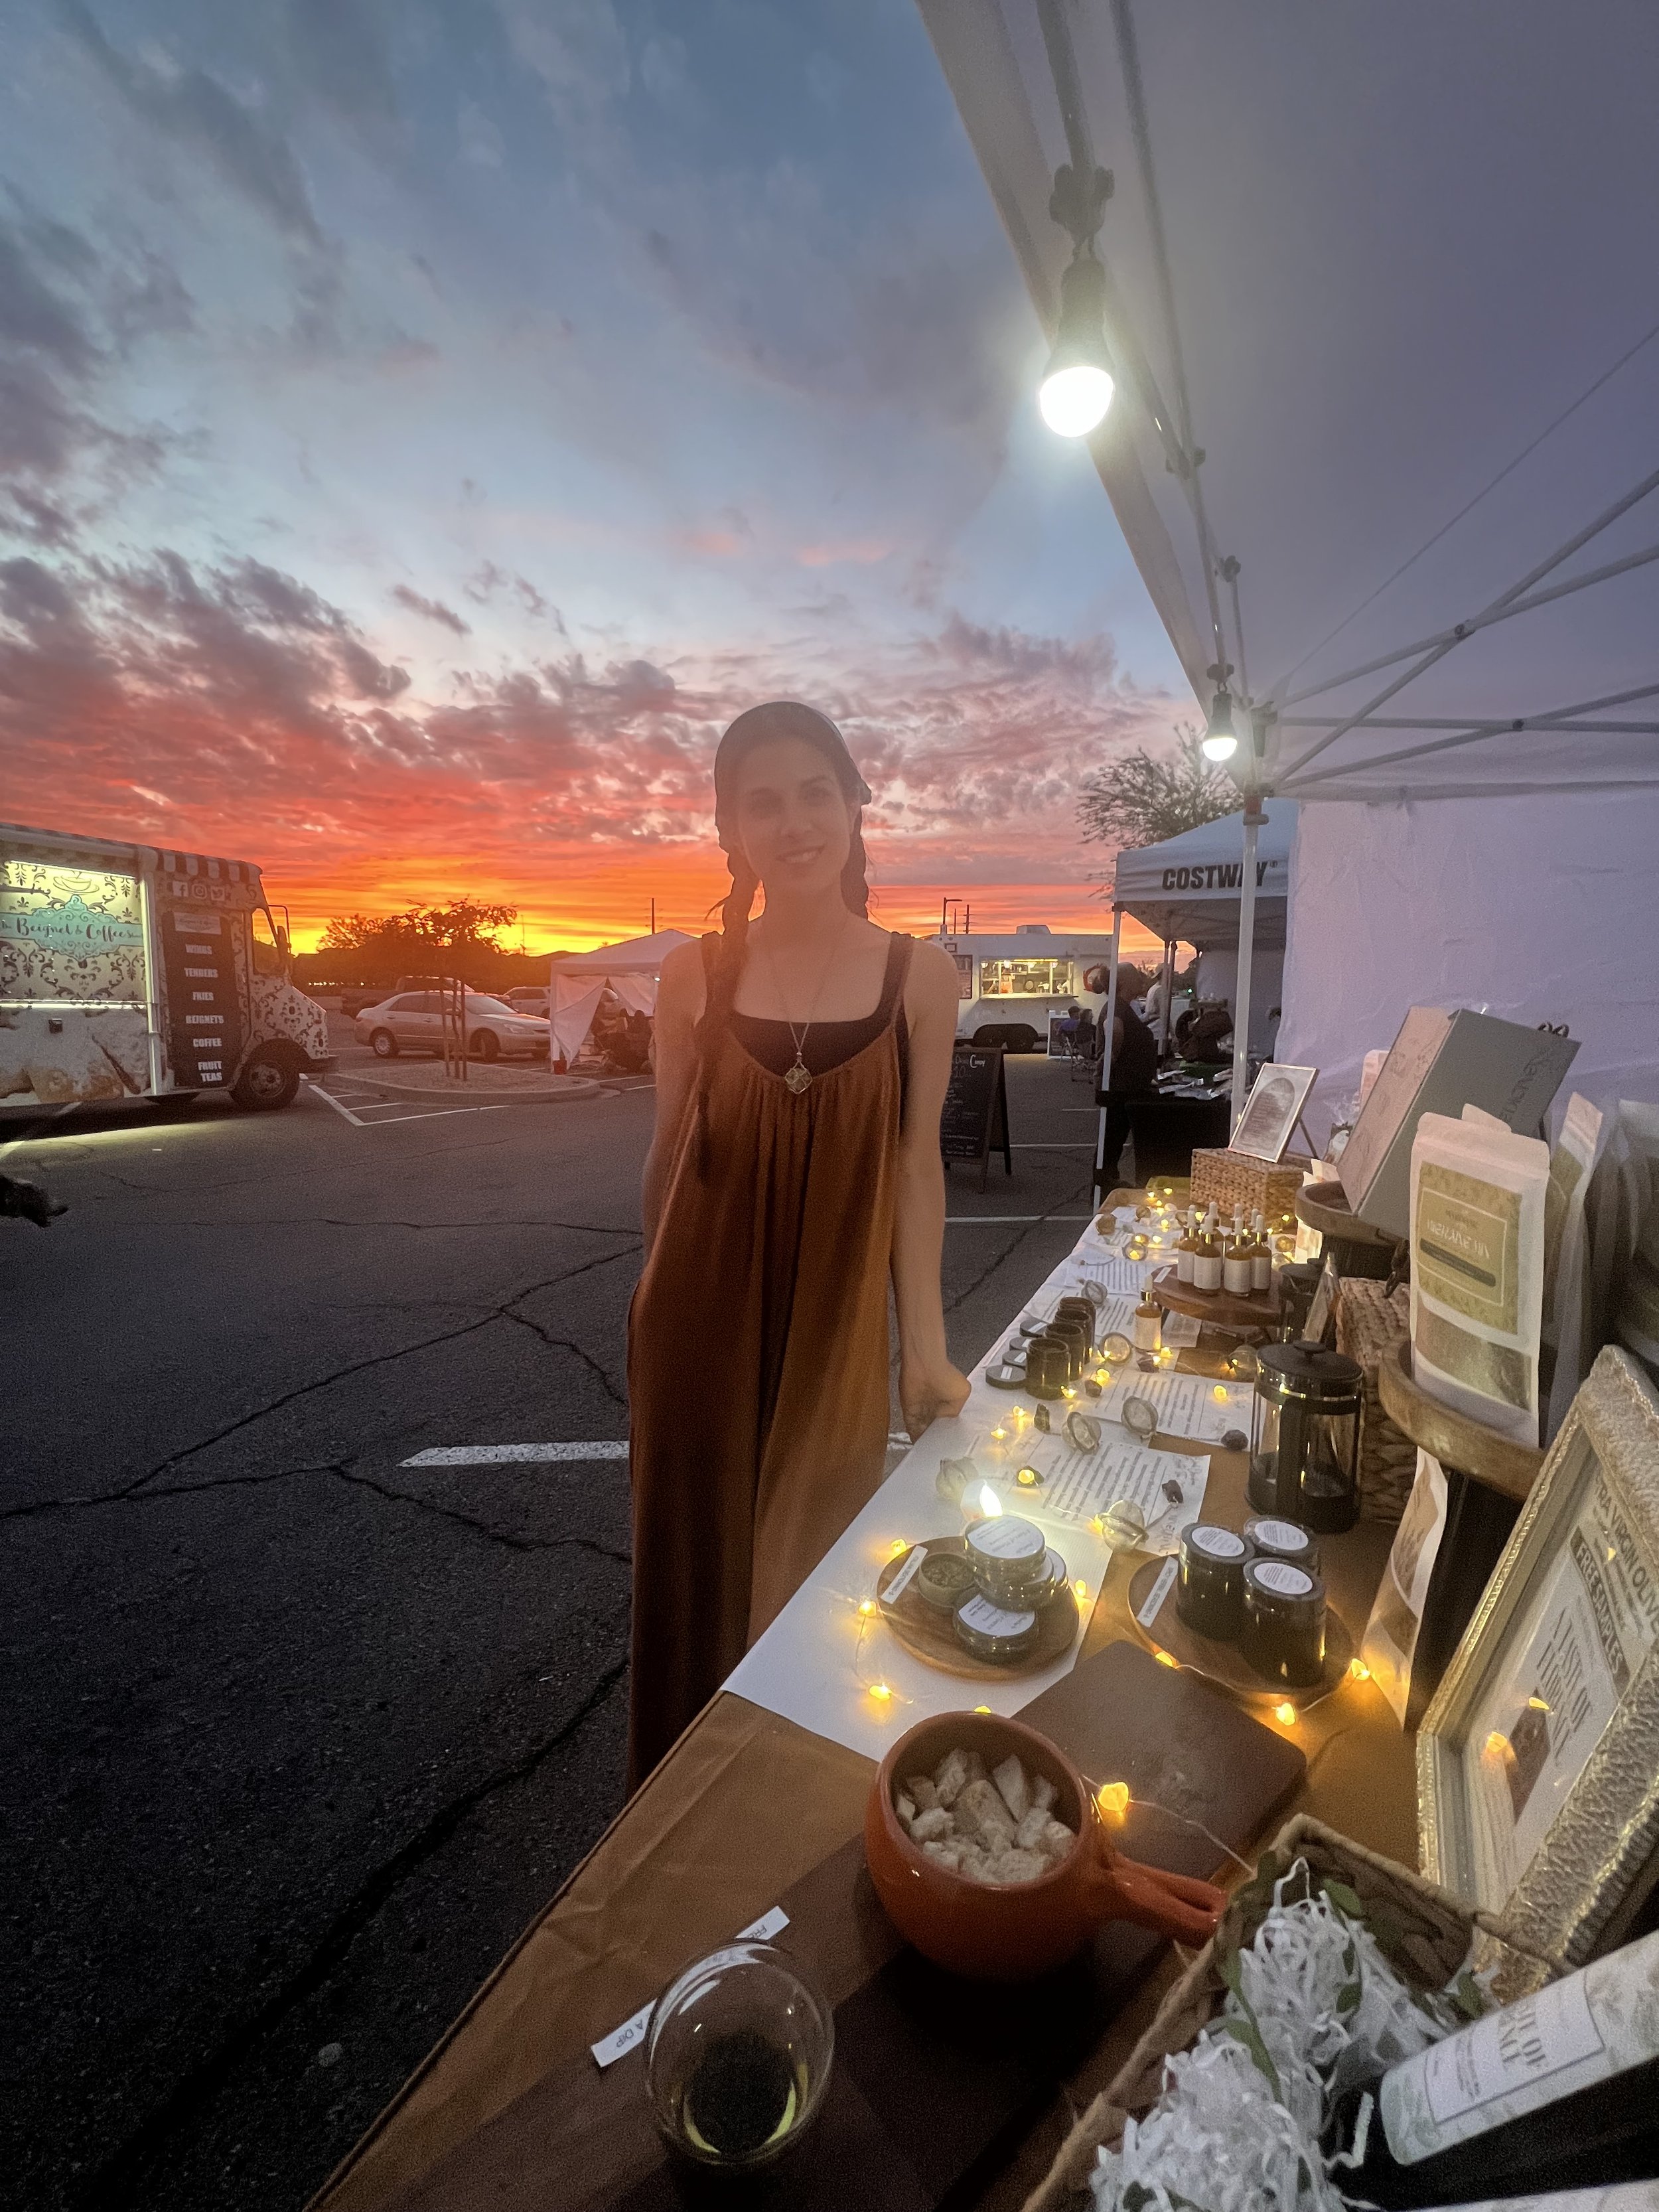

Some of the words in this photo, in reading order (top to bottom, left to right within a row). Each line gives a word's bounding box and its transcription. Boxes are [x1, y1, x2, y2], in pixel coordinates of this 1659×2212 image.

[17, 917, 73, 937] Beignet
[75, 924, 84, 935] &
[86, 923, 126, 942] Coffee
[185, 944, 212, 955] WINGS
[184, 968, 218, 978] TENDERS
[192, 992, 214, 1001] FRIES
[186, 1015, 224, 1024] BEIGNETS
[193, 1038, 223, 1047] COFFEE
[198, 1061, 222, 1071] FRUIT
[200, 1072, 223, 1082] TEAS
[1575, 1540, 1600, 1592] FREE
[1594, 1584, 1624, 1674] SAMPLES
[616, 2028, 634, 2047] DIP
